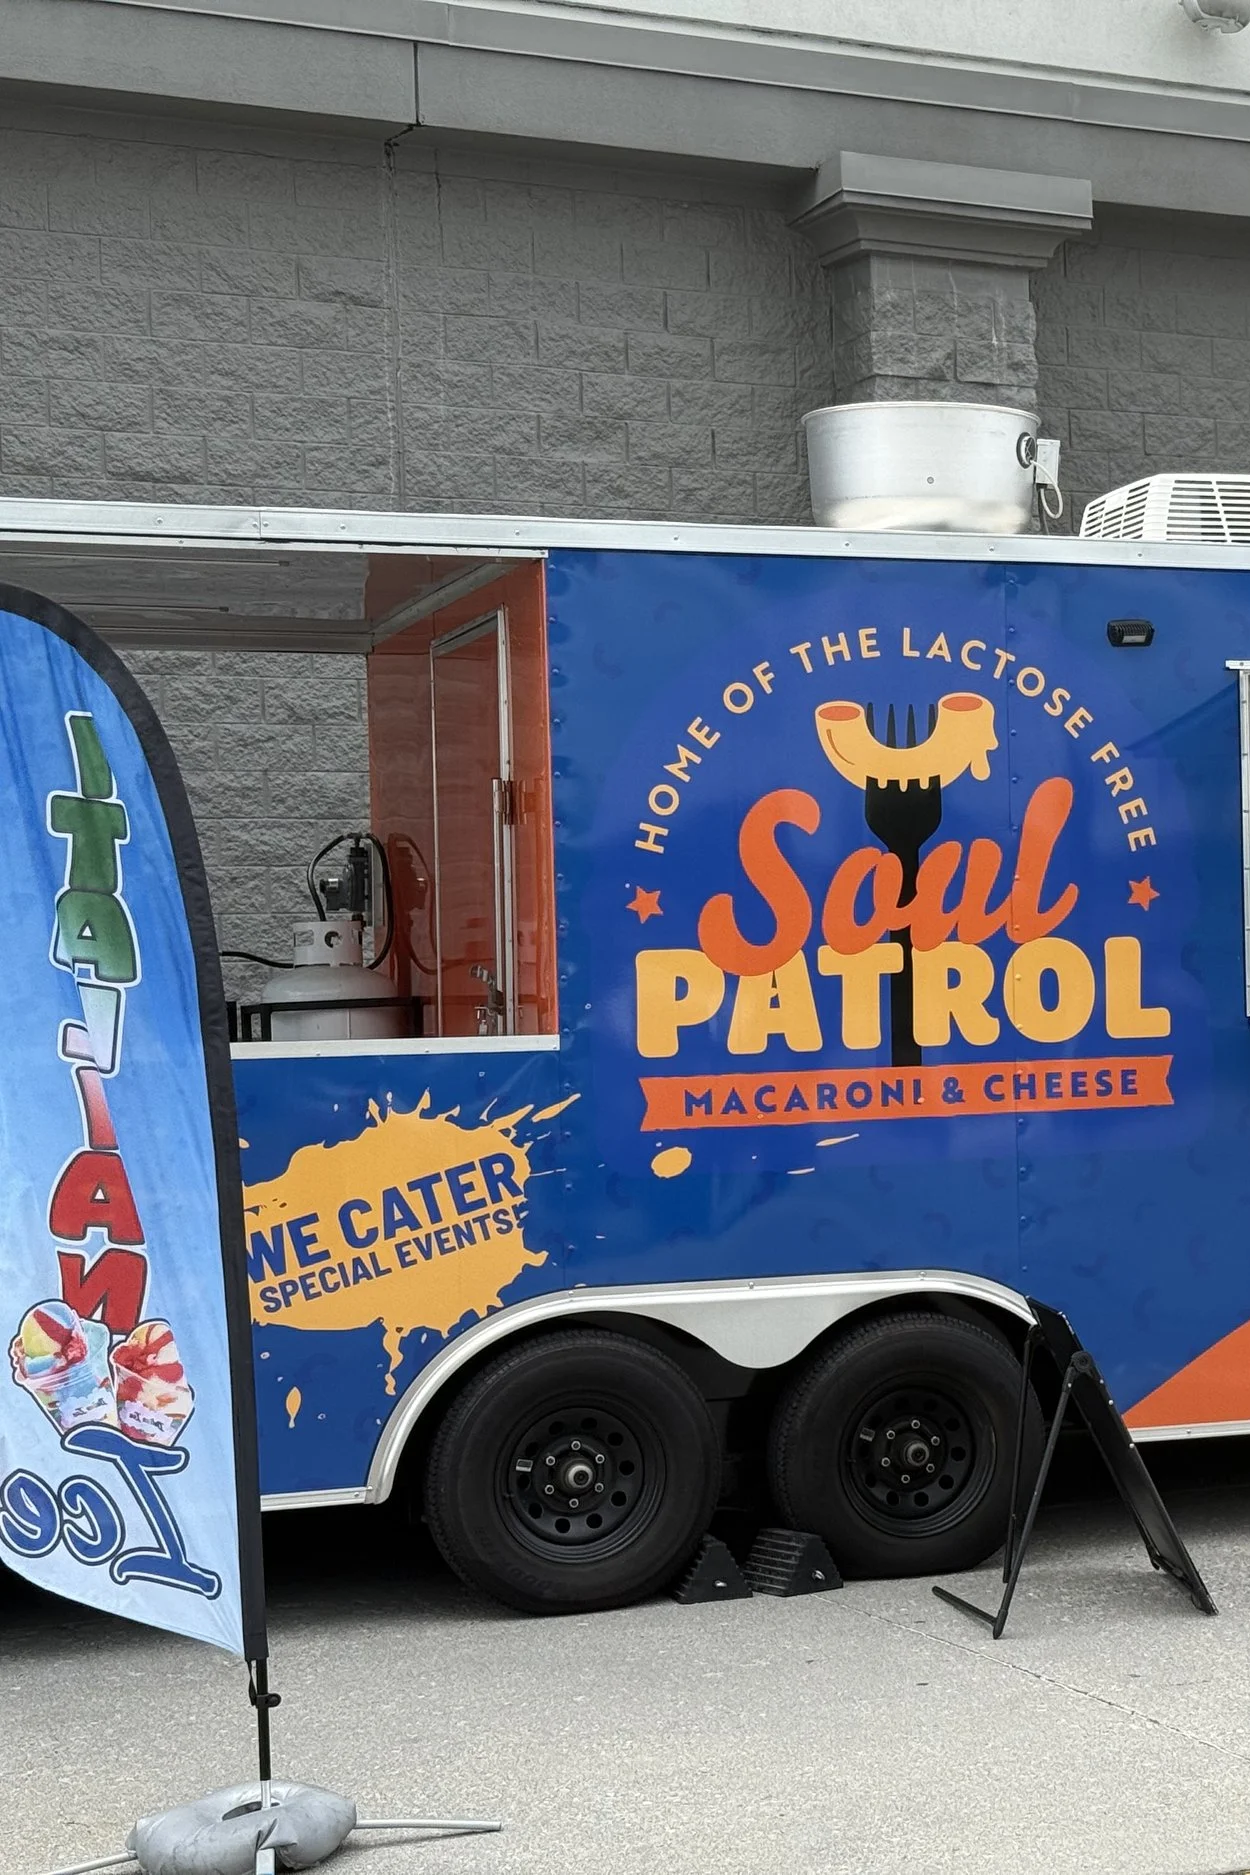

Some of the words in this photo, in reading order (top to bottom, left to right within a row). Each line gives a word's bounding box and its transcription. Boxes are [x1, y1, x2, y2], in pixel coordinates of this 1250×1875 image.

[634, 716, 721, 855] HOME
[722, 662, 776, 714] OF
[789, 627, 881, 674] THE
[902, 627, 1093, 739] LACTOSE
[1090, 740, 1157, 853] FREE
[698, 777, 1078, 977] Soul
[636, 936, 1171, 1058] PATROL
[684, 1080, 922, 1117] MACARONI
[941, 1078, 964, 1103] &
[983, 1069, 1139, 1101] CHEESE
[248, 1212, 331, 1284] WE
[338, 1153, 524, 1249] CATER
[259, 1252, 392, 1313] SPECIAL
